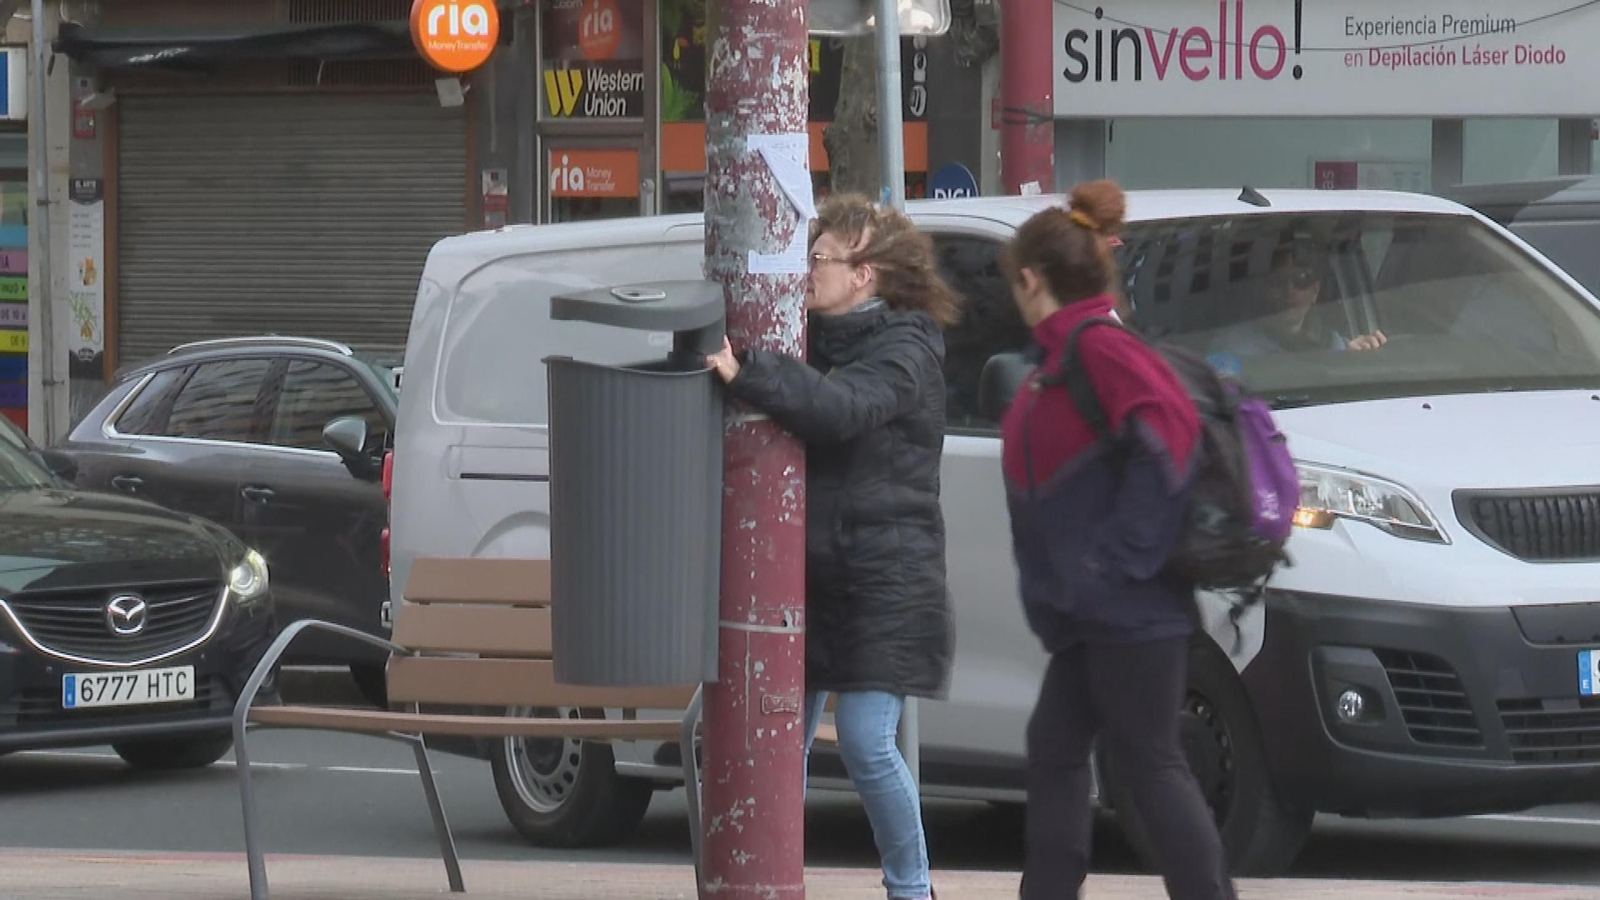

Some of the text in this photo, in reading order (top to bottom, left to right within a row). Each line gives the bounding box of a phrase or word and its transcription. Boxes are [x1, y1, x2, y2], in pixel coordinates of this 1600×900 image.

[428, 0, 489, 36] ria
[583, 0, 614, 38] ria
[1345, 13, 1516, 40] Experiencia Premium
[428, 40, 488, 52] Money Transfer
[1063, 0, 1303, 83] sinvello!
[1344, 43, 1566, 71] en Depilación Láser Diodo
[587, 68, 644, 92] Western
[584, 92, 627, 116] Union
[551, 154, 584, 191] ria
[586, 167, 612, 180] Money
[586, 180, 616, 191] Transfer
[80, 671, 187, 702] 6777 HTC
